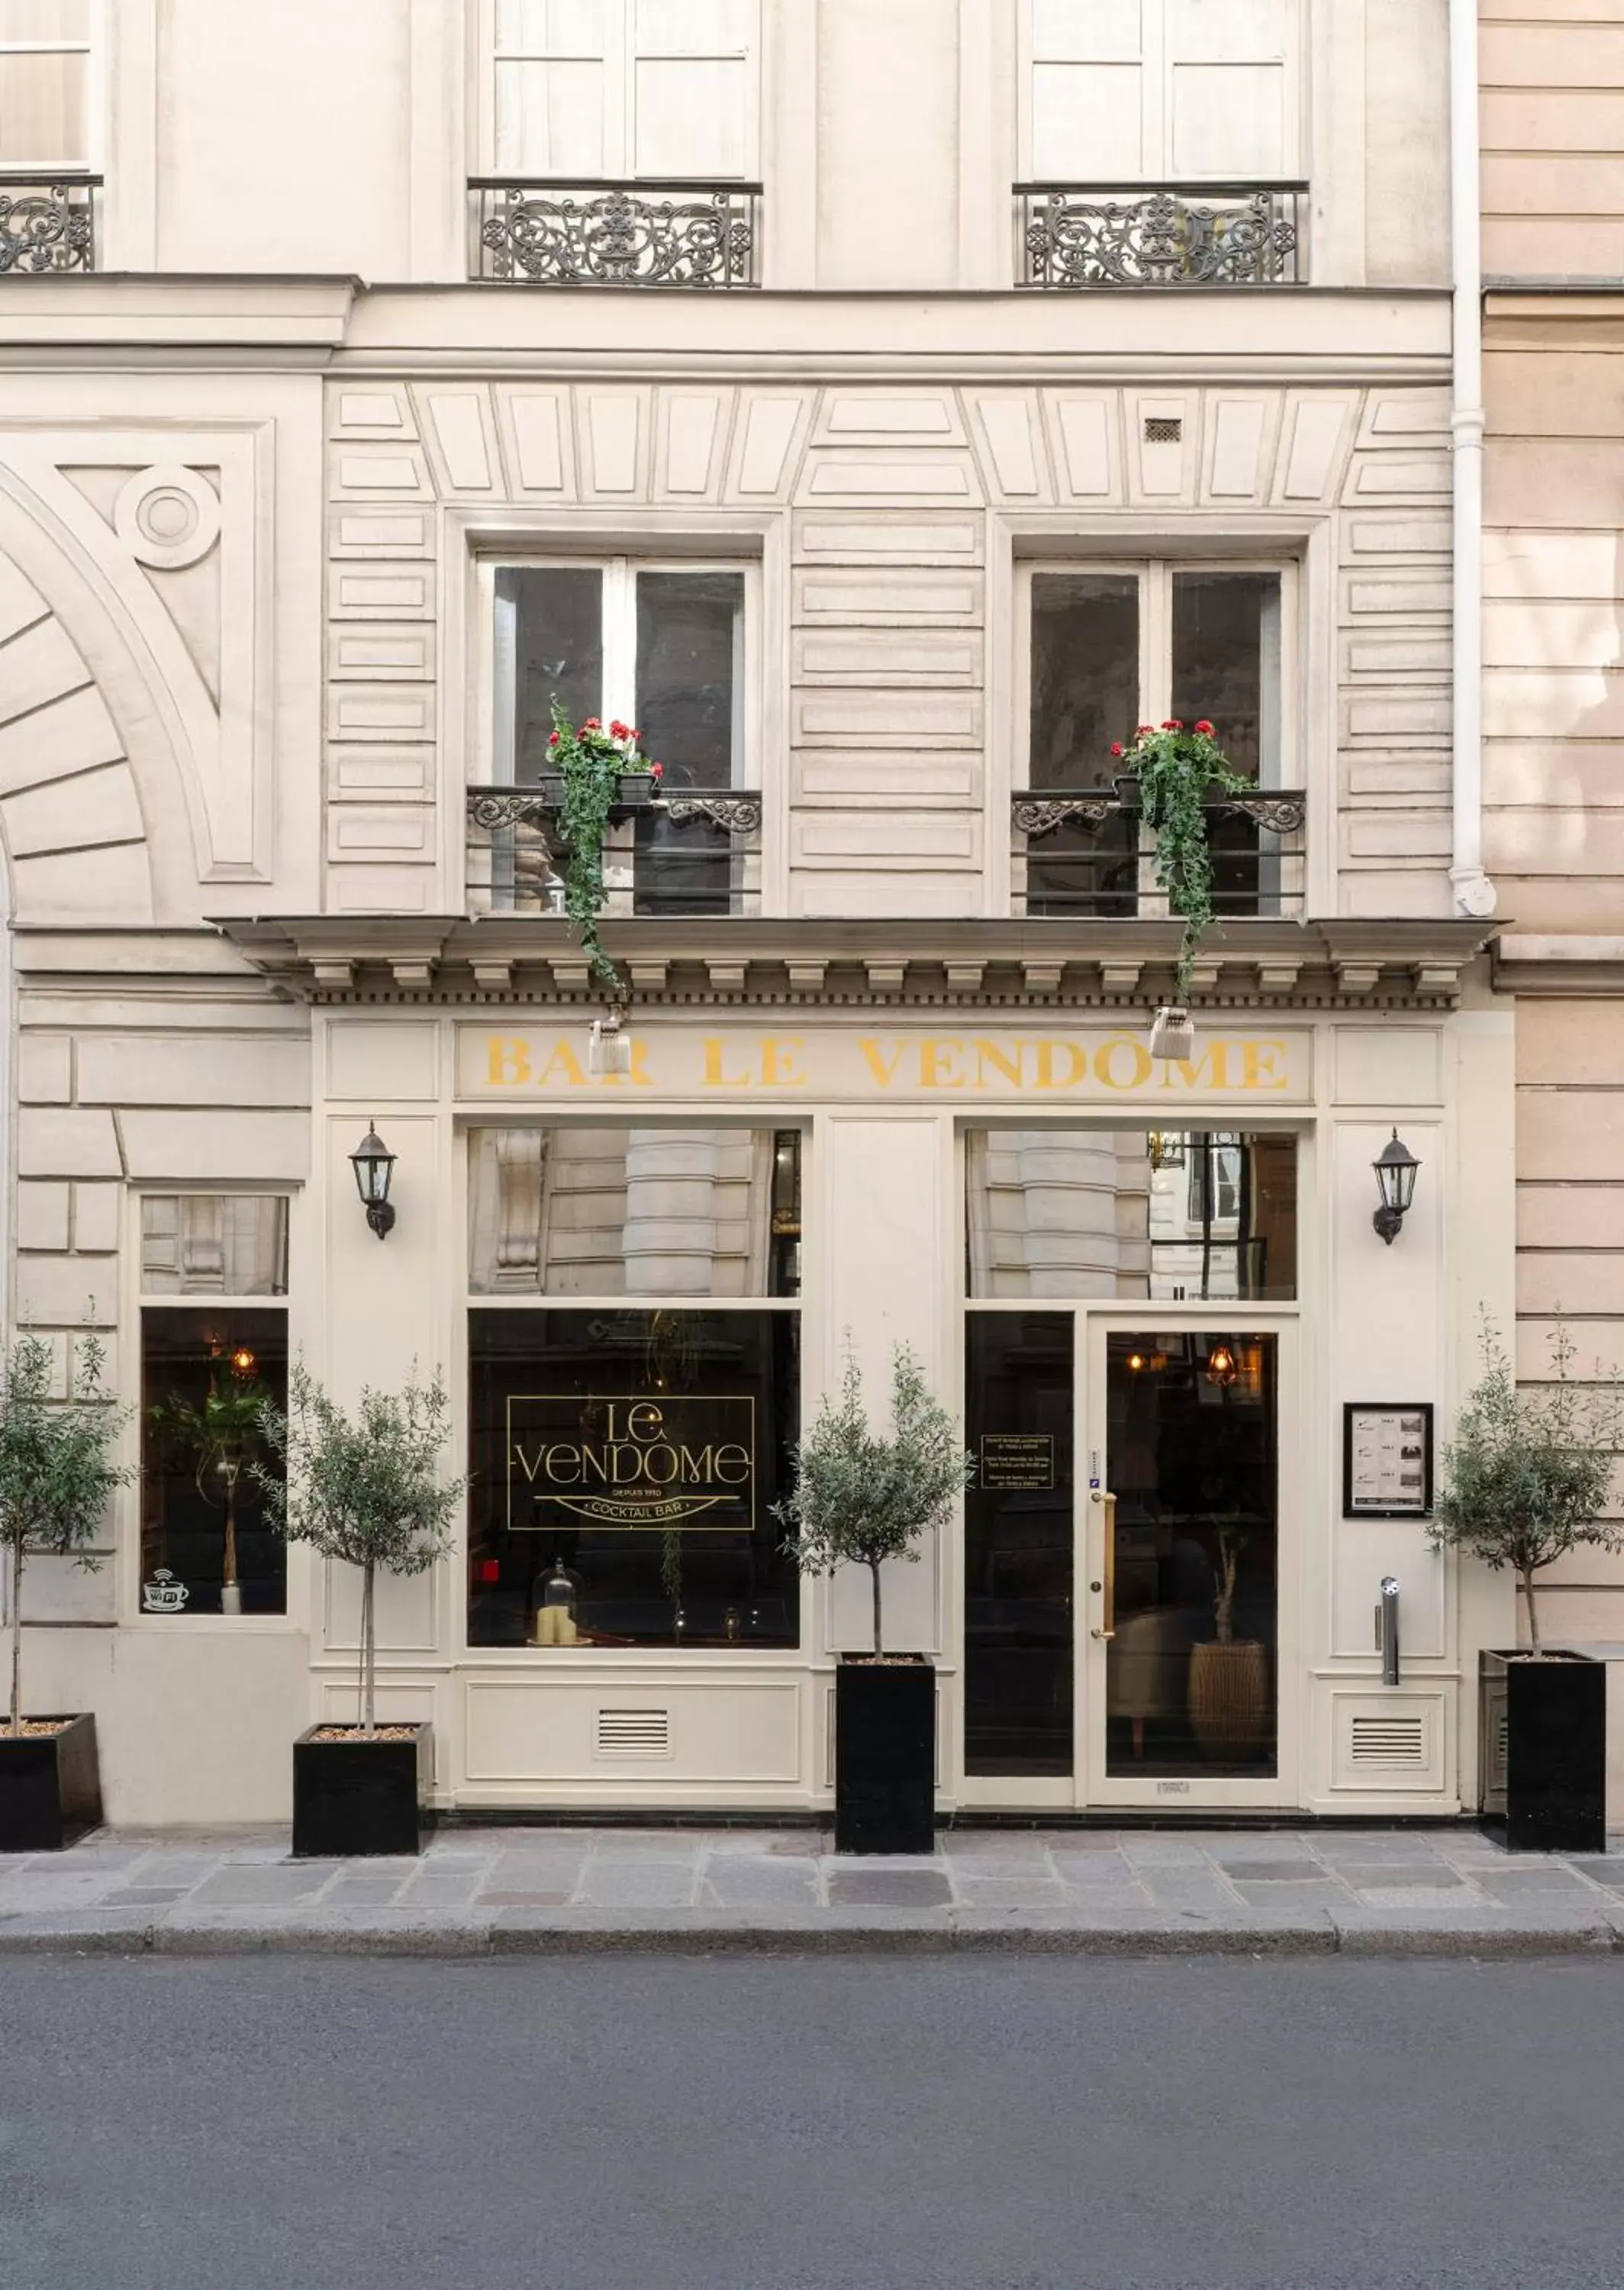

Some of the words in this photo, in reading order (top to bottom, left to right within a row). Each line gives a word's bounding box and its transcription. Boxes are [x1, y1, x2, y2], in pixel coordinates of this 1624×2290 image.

[701, 1036, 808, 1087] LE
[857, 1028, 1289, 1089] VENDÔME
[591, 1501, 654, 1518] COCKTAIL
[655, 1501, 684, 1518] BAR
